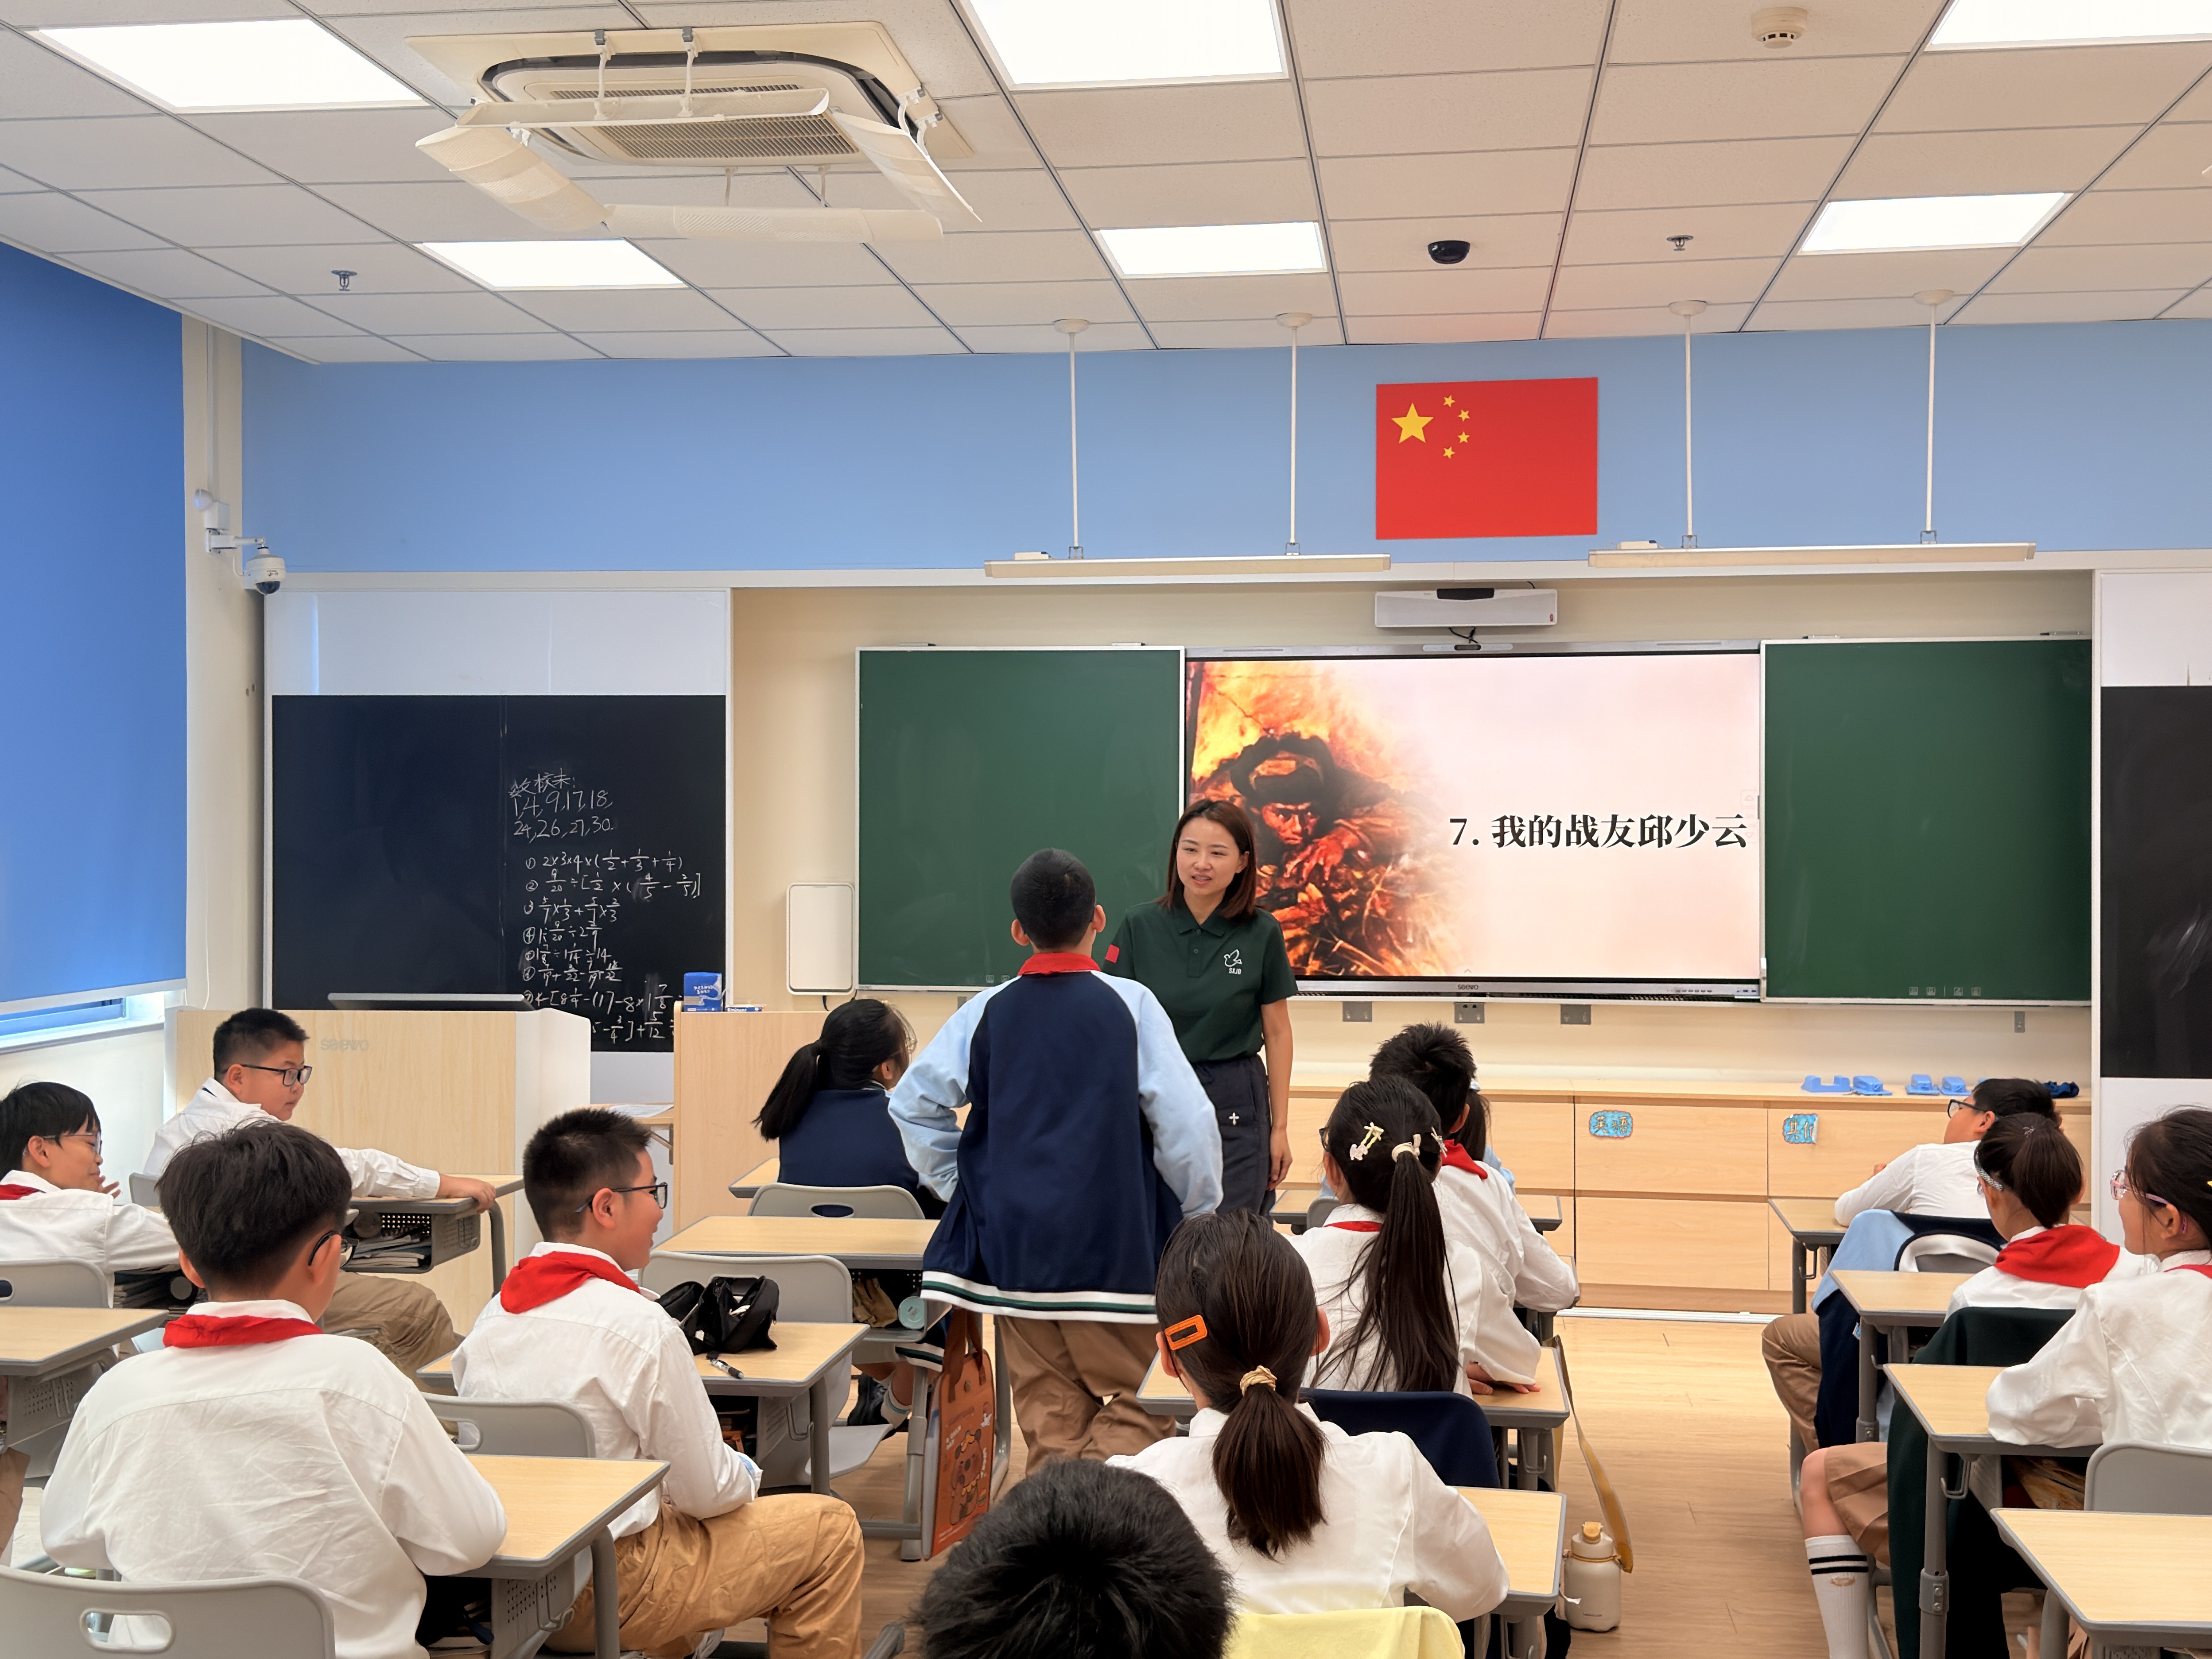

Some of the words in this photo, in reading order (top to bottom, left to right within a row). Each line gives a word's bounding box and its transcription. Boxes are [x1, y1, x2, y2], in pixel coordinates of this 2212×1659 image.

[1491, 814, 1747, 848] 我的战友邱少云
[1592, 1115, 1628, 1134] 英语
